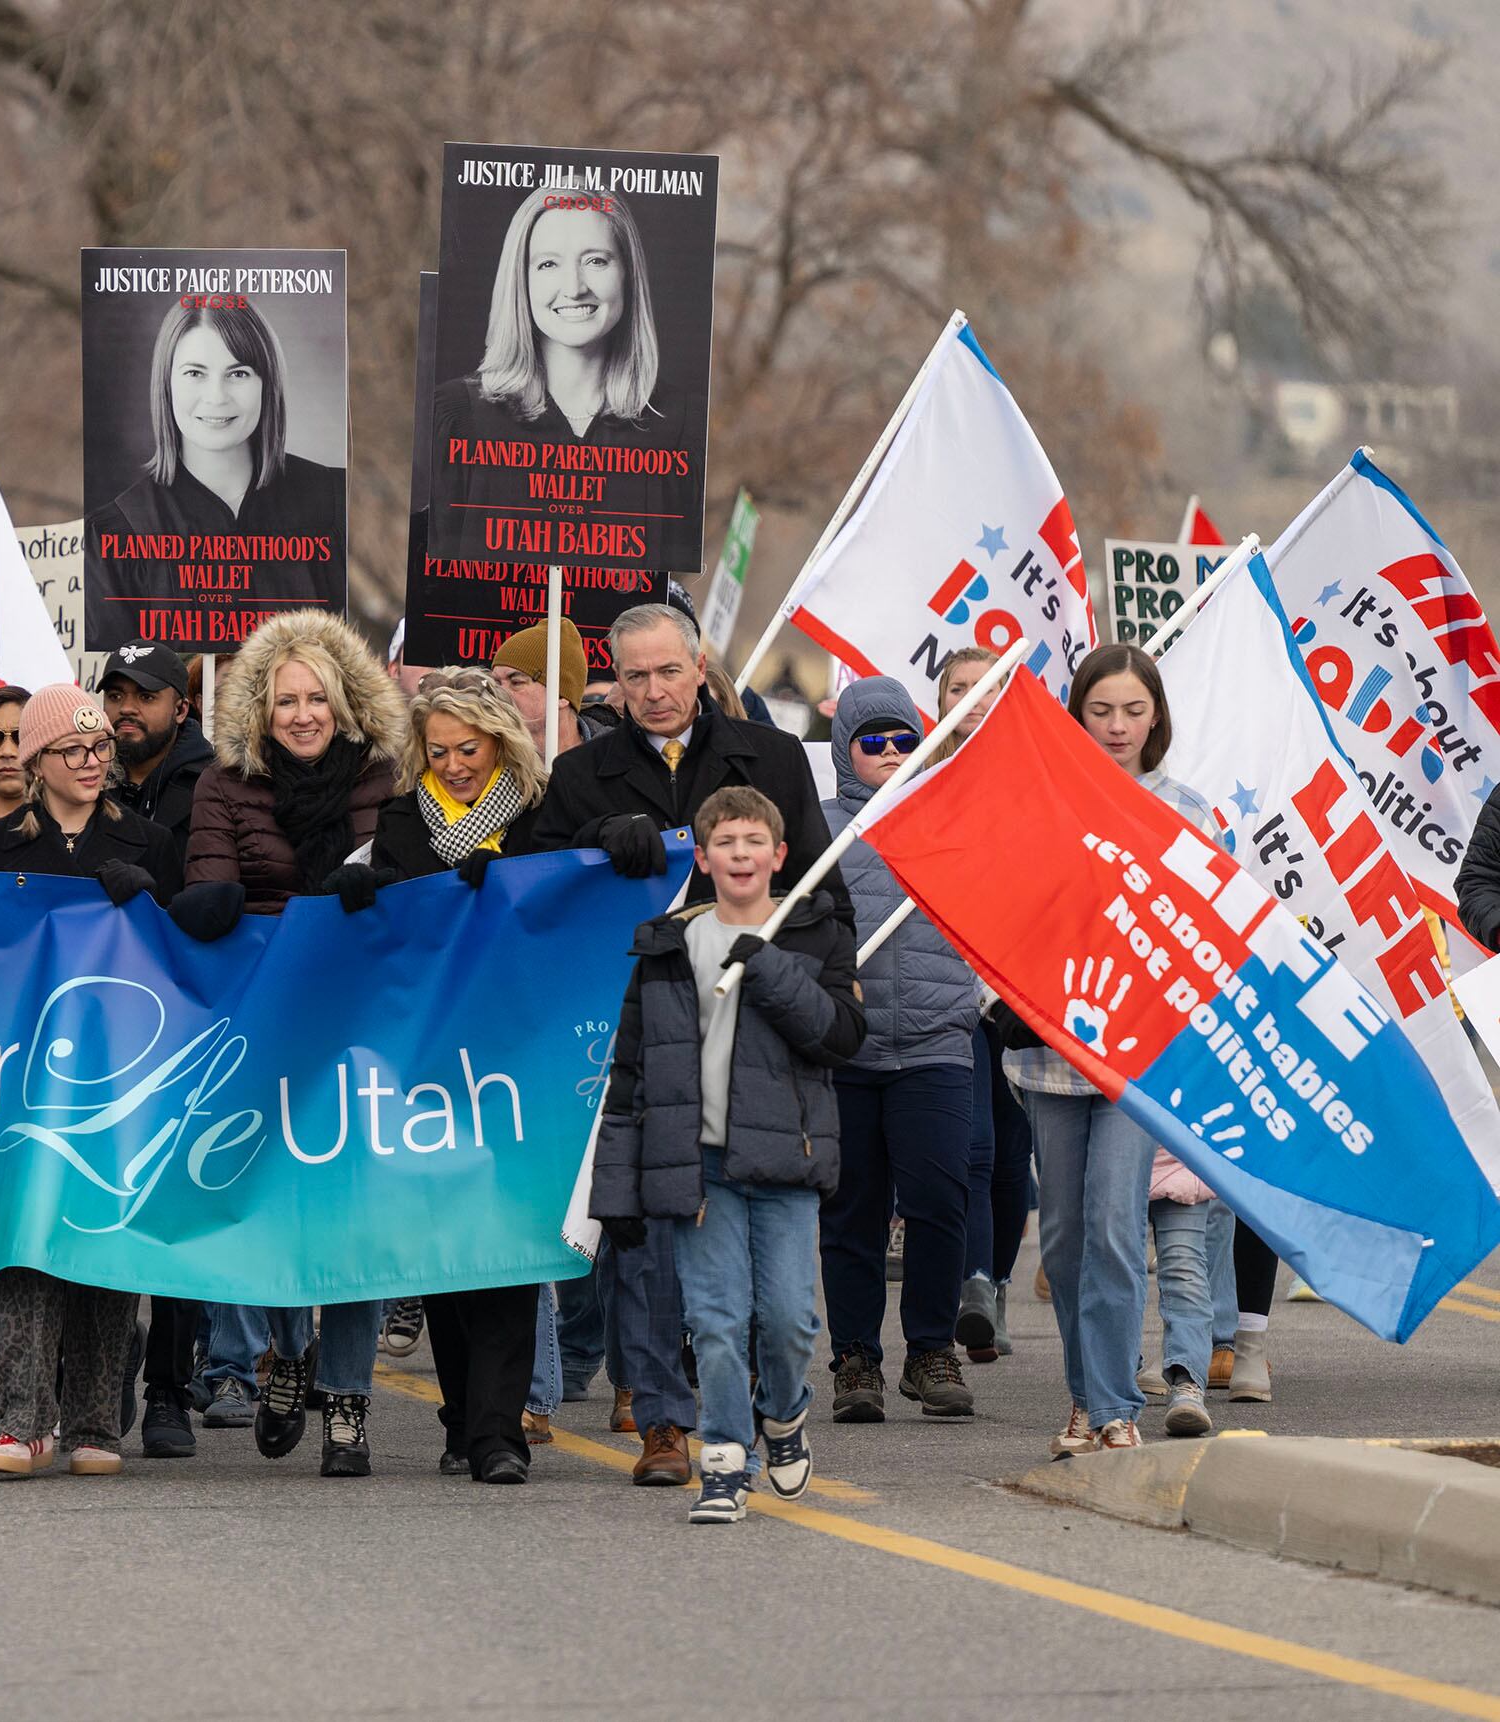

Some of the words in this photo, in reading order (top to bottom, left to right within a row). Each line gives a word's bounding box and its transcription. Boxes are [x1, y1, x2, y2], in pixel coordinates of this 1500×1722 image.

[457, 159, 535, 189] JUSTICE
[538, 163, 582, 191] JILL
[585, 166, 606, 192] M.
[609, 167, 703, 197] POHLMAN
[543, 195, 615, 213] CHOSE
[94, 267, 170, 294] JUSTICE
[174, 268, 230, 294] PAIGE
[235, 268, 333, 295] PETERSON
[180, 294, 248, 310] CHOSE
[448, 438, 536, 468] PLANNED
[541, 442, 689, 476] PARENTHOOD'S
[528, 473, 606, 502] WALLET
[548, 504, 584, 516] OVER
[101, 534, 185, 560] PLANNED
[189, 534, 331, 562] PARENTHOOD'S
[485, 517, 555, 552] UTAH
[558, 523, 646, 558] BABIES
[178, 564, 253, 590] WALLET
[1113, 549, 1180, 584] PRO
[198, 593, 233, 604] OVER
[500, 586, 575, 615] WALLT
[1010, 549, 1060, 622] It's
[139, 610, 201, 641] UTAH
[208, 610, 278, 642] BAB
[1340, 586, 1399, 648] It's
[458, 628, 511, 660] UTA
[1347, 757, 1465, 865] olitics
[1252, 813, 1304, 900] It's
[1291, 758, 1447, 1020] LIFE
[1159, 828, 1392, 1062] LIFE
[574, 1020, 609, 1038] PRO
[1103, 893, 1172, 981] Not
[1163, 976, 1297, 1142] politics
[1150, 893, 1260, 1021] about
[1252, 1012, 1374, 1155] babies
[279, 1048, 524, 1165] Utah
